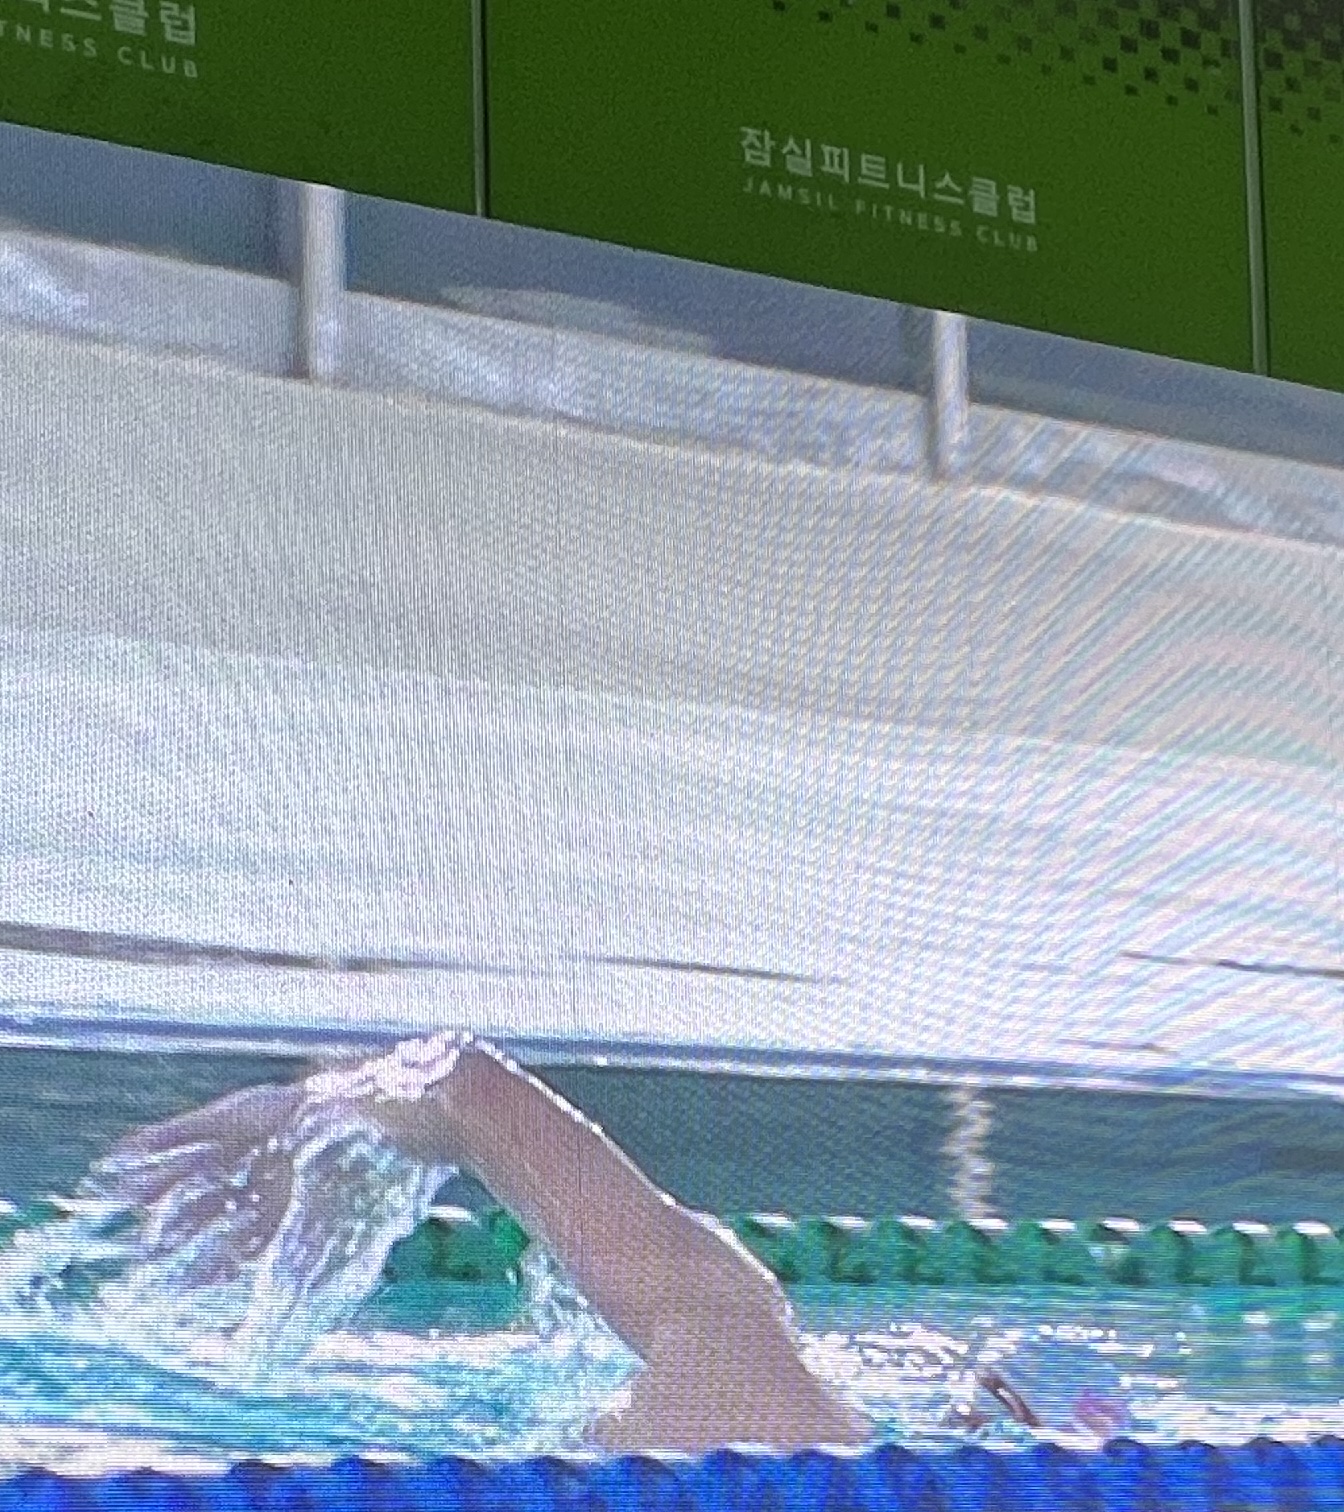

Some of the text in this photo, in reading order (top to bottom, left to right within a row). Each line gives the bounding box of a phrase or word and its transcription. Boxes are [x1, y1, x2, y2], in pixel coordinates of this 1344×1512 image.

[117, 46, 198, 77] CLUB
[740, 126, 1035, 224] 잠실피트니스클럽
[742, 177, 1038, 252] JAMSIL FITNESS CLUB
